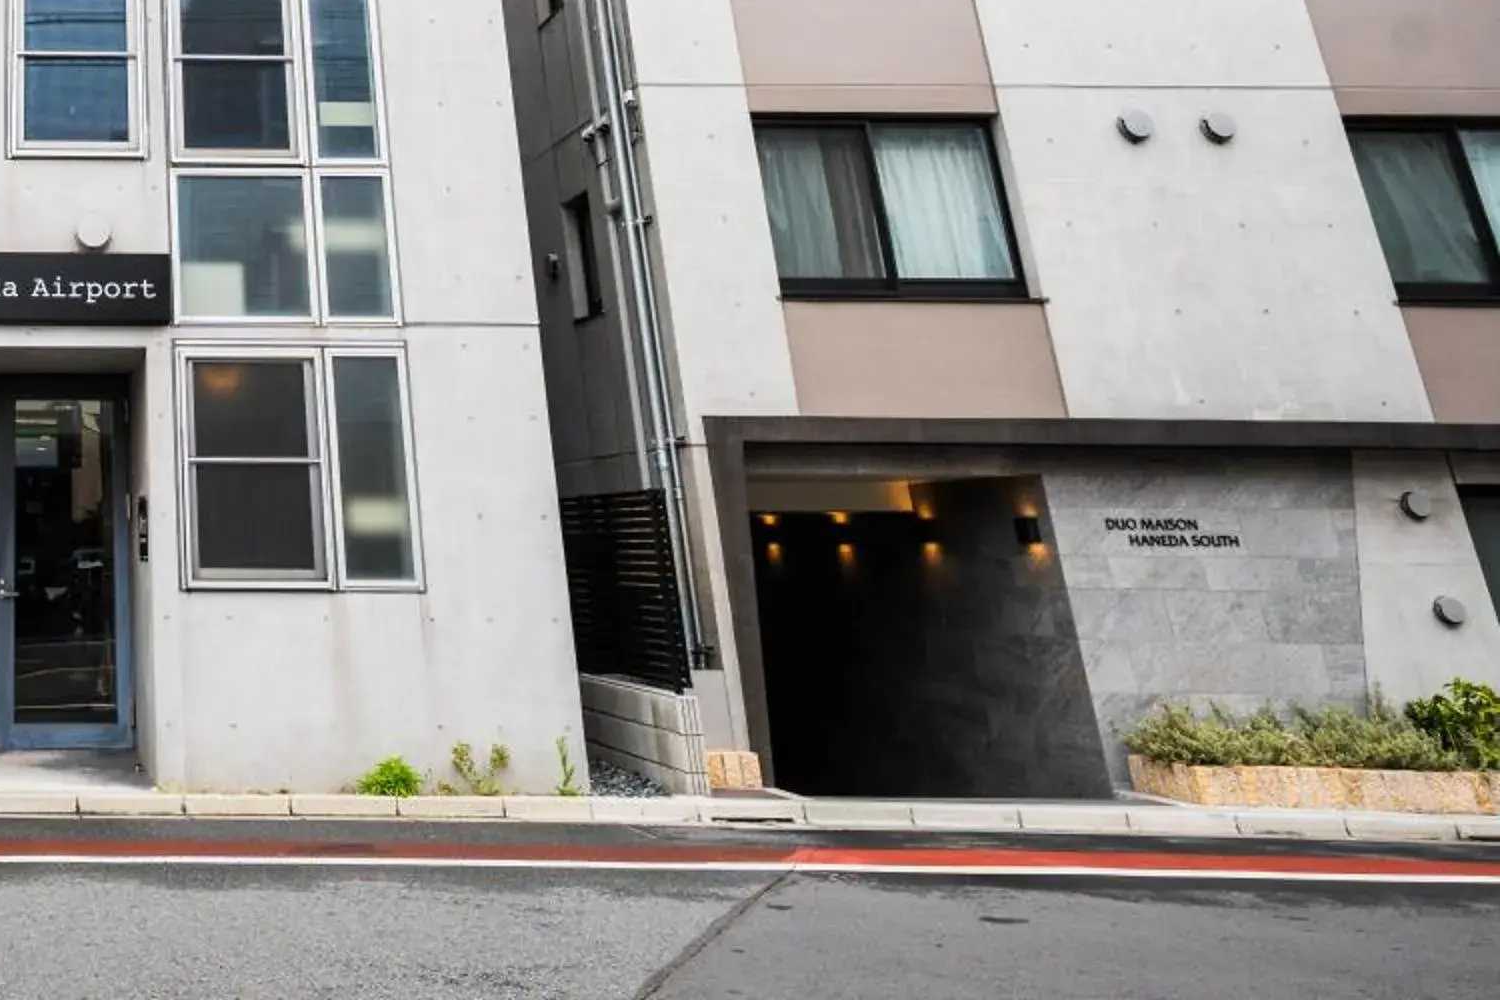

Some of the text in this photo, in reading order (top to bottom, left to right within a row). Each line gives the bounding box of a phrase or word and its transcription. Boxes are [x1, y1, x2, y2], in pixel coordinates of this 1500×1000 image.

[32, 277, 156, 303] Airport
[1105, 518, 1198, 530] DUO MAISON
[1129, 535, 1240, 546] HANEDA SOUTH
